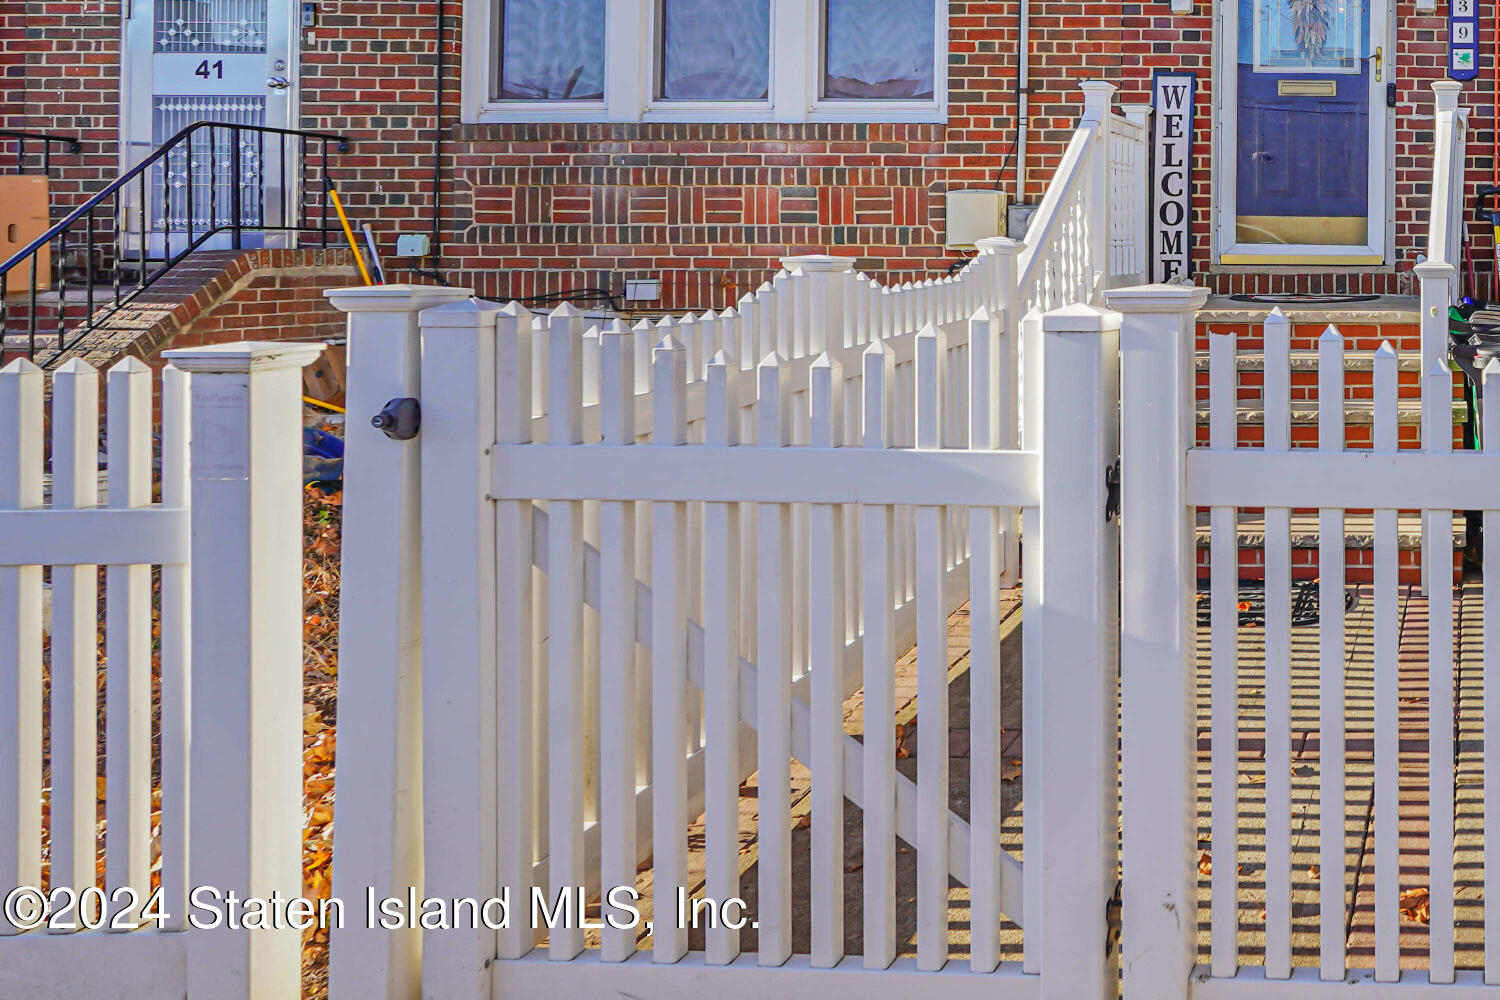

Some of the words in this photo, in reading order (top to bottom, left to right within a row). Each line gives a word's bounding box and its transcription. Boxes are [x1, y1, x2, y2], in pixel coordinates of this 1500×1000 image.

[1458, 0, 1468, 39] 39
[194, 59, 223, 79] 41
[1159, 84, 1188, 284] WELCOME
